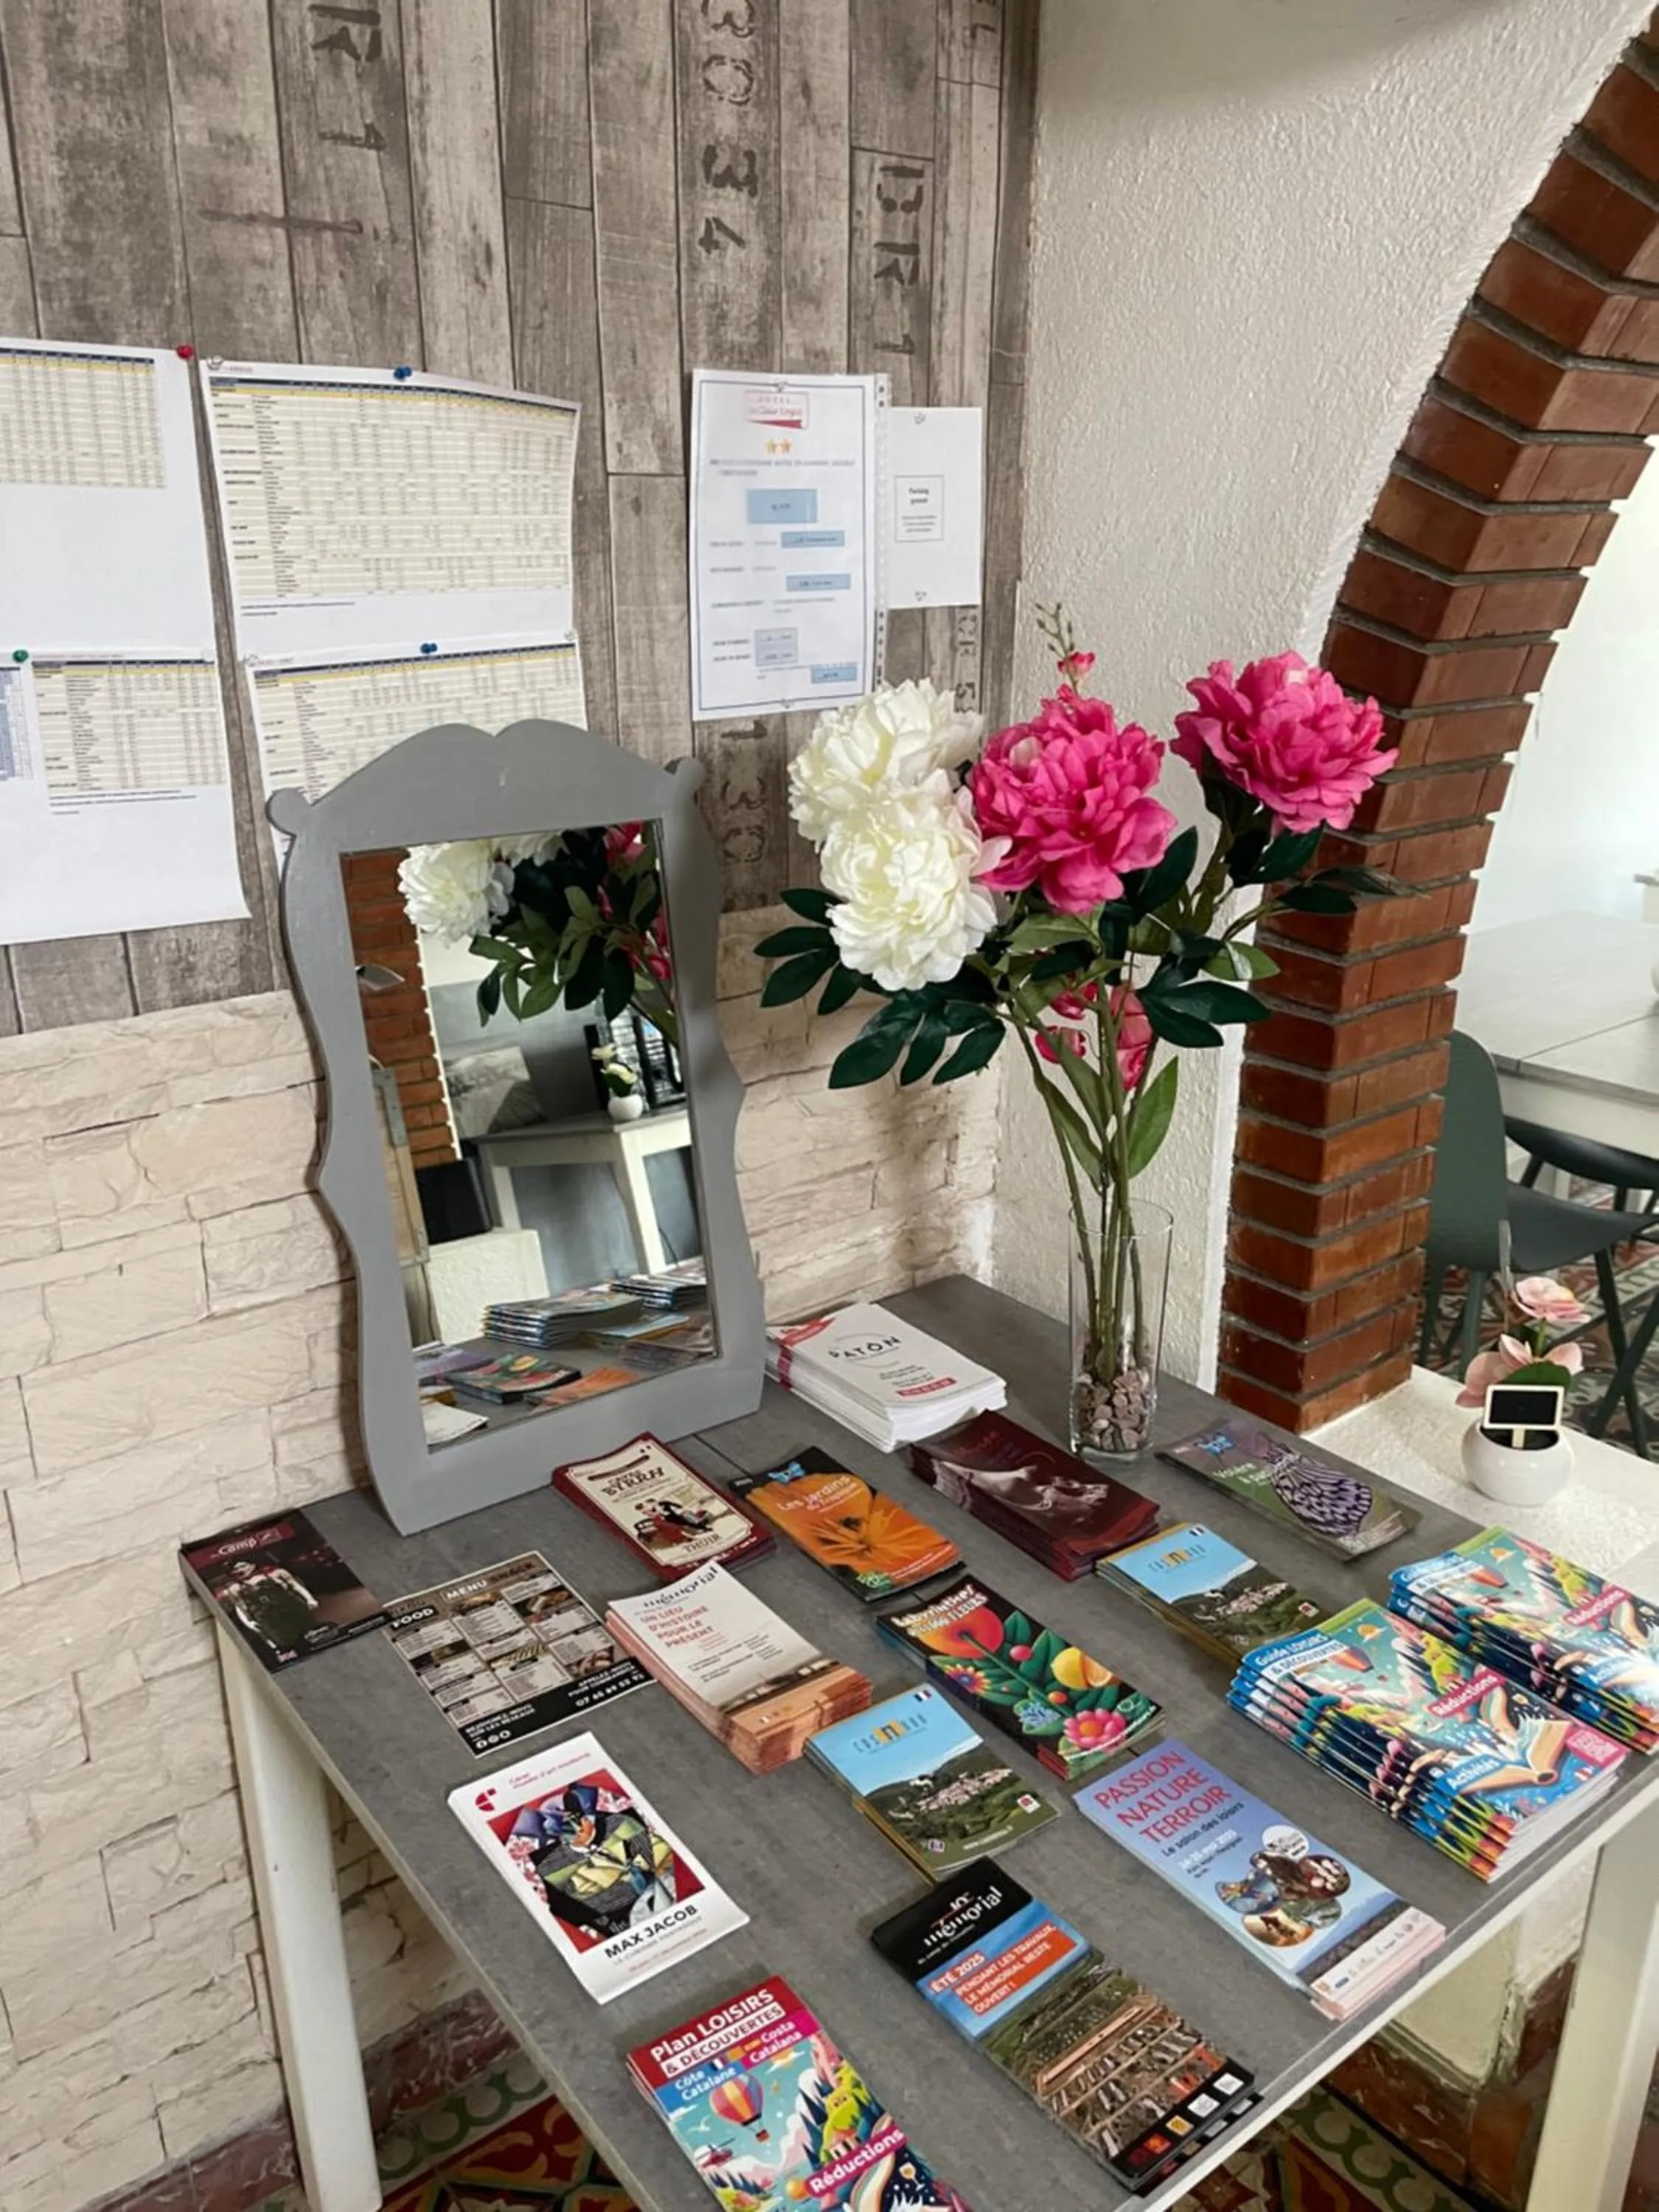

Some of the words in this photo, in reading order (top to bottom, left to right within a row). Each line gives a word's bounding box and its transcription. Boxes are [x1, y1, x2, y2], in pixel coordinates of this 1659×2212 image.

[601, 1467, 664, 1496] BYRRH
[683, 1534, 721, 1554] THUIR
[445, 1579, 488, 1600] MENU
[643, 1566, 719, 1609] mémorial
[391, 1607, 435, 1629] FOOD
[1254, 1646, 1290, 1666] Guide
[1432, 1674, 1498, 1714] Réductions
[1093, 1750, 1188, 1809] PASSION
[1447, 1758, 1501, 1790] Activités
[1116, 1768, 1209, 1829] NATURE
[1138, 1785, 1234, 1844] TERROIR
[1161, 1846, 1176, 1857] Le
[1200, 1818, 1220, 1832] des
[605, 1933, 644, 1960] MAX
[644, 1905, 699, 1939] JACOB
[923, 1885, 1003, 1947] mémorial
[930, 1969, 959, 1994] ÉTÉ
[955, 1952, 985, 1977] 2025
[956, 1962, 998, 1996] PENDANT
[997, 1952, 1017, 1971] LES
[964, 1992, 979, 2006] LE
[1022, 1941, 1053, 1965] RESTE
[973, 1983, 1012, 2014] OUVERT
[650, 2031, 698, 2062] Plan
[697, 1989, 774, 2037] LOISIRS
[760, 2020, 796, 2043] Costa
[749, 2030, 803, 2063] Catalana
[666, 2062, 678, 2075] &
[675, 2070, 706, 2091] Côte
[681, 2066, 737, 2101] Catalane
[808, 2127, 905, 2196] Réductions
